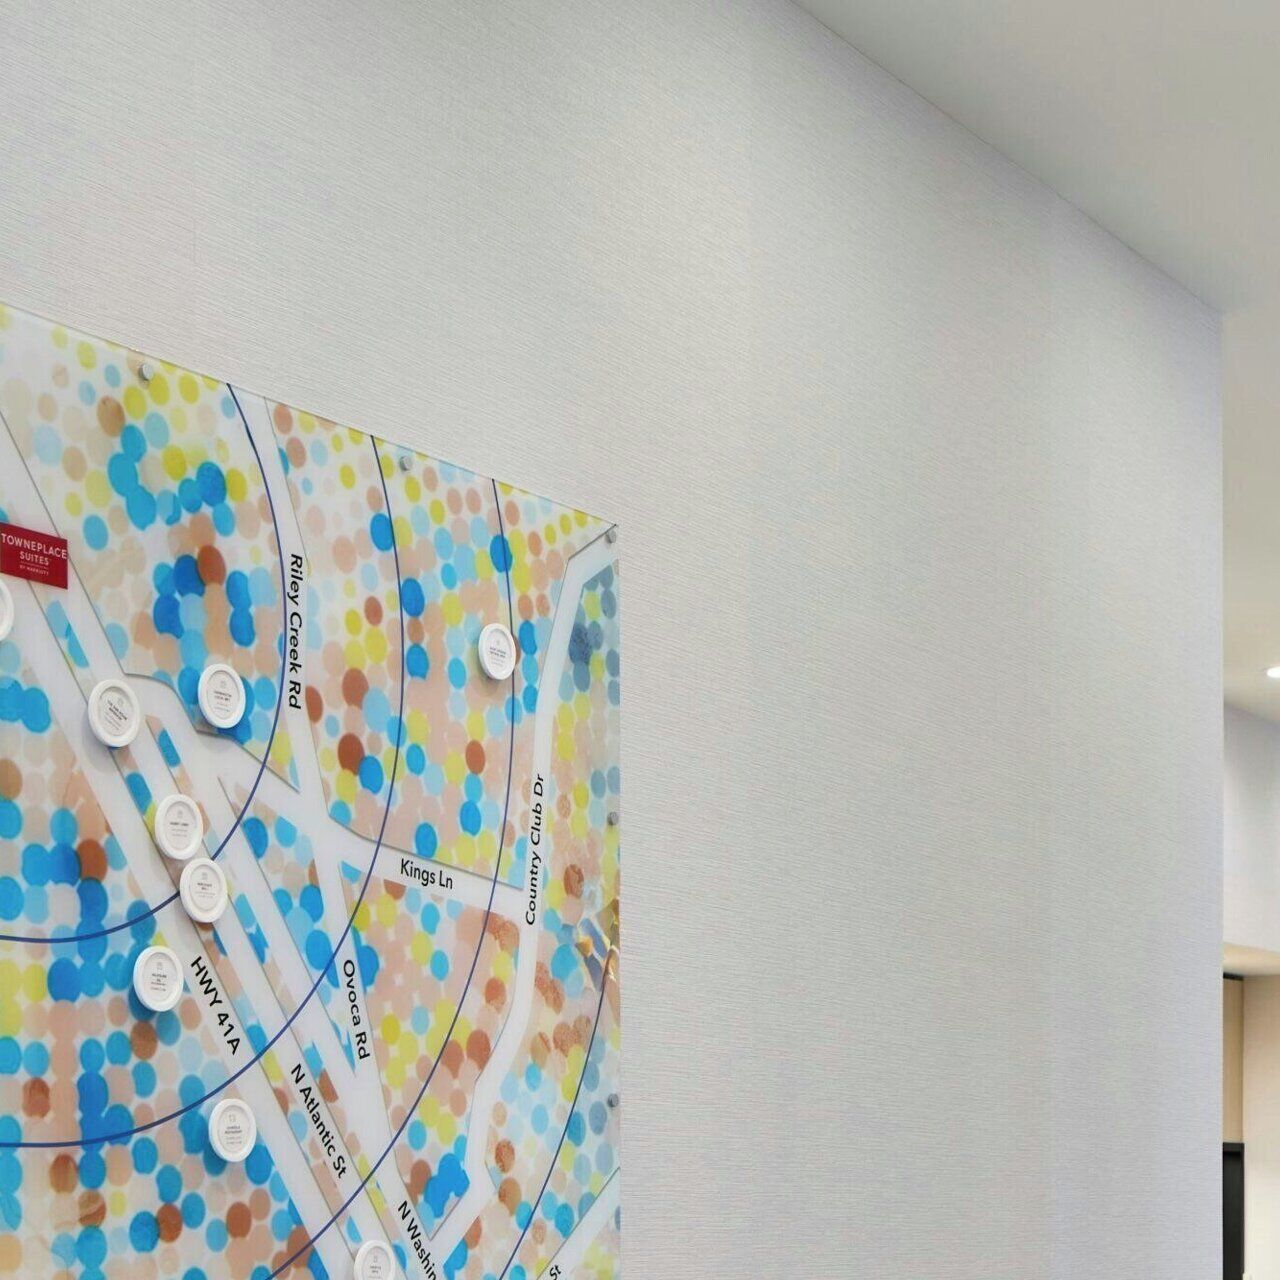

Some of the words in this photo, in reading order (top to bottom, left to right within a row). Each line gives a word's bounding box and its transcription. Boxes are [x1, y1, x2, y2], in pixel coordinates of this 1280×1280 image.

[1, 533, 67, 559] TOWNEPLACE
[20, 551, 49, 566] SUITES
[287, 553, 303, 606] Riley
[289, 611, 303, 674] Creek
[288, 680, 301, 709] Rd
[534, 773, 545, 798] Dr
[530, 801, 544, 846] Club
[400, 858, 436, 886] Kings
[438, 869, 453, 890] Ln
[525, 847, 543, 926] Country
[190, 956, 222, 1007] HWY
[217, 1012, 242, 1056] 41A
[343, 960, 362, 1027] Ovoca
[356, 1032, 370, 1060] Rd
[291, 1063, 305, 1084] N
[299, 1085, 339, 1158] Atlantic
[333, 1157, 347, 1179] St
[397, 1200, 411, 1220] N
